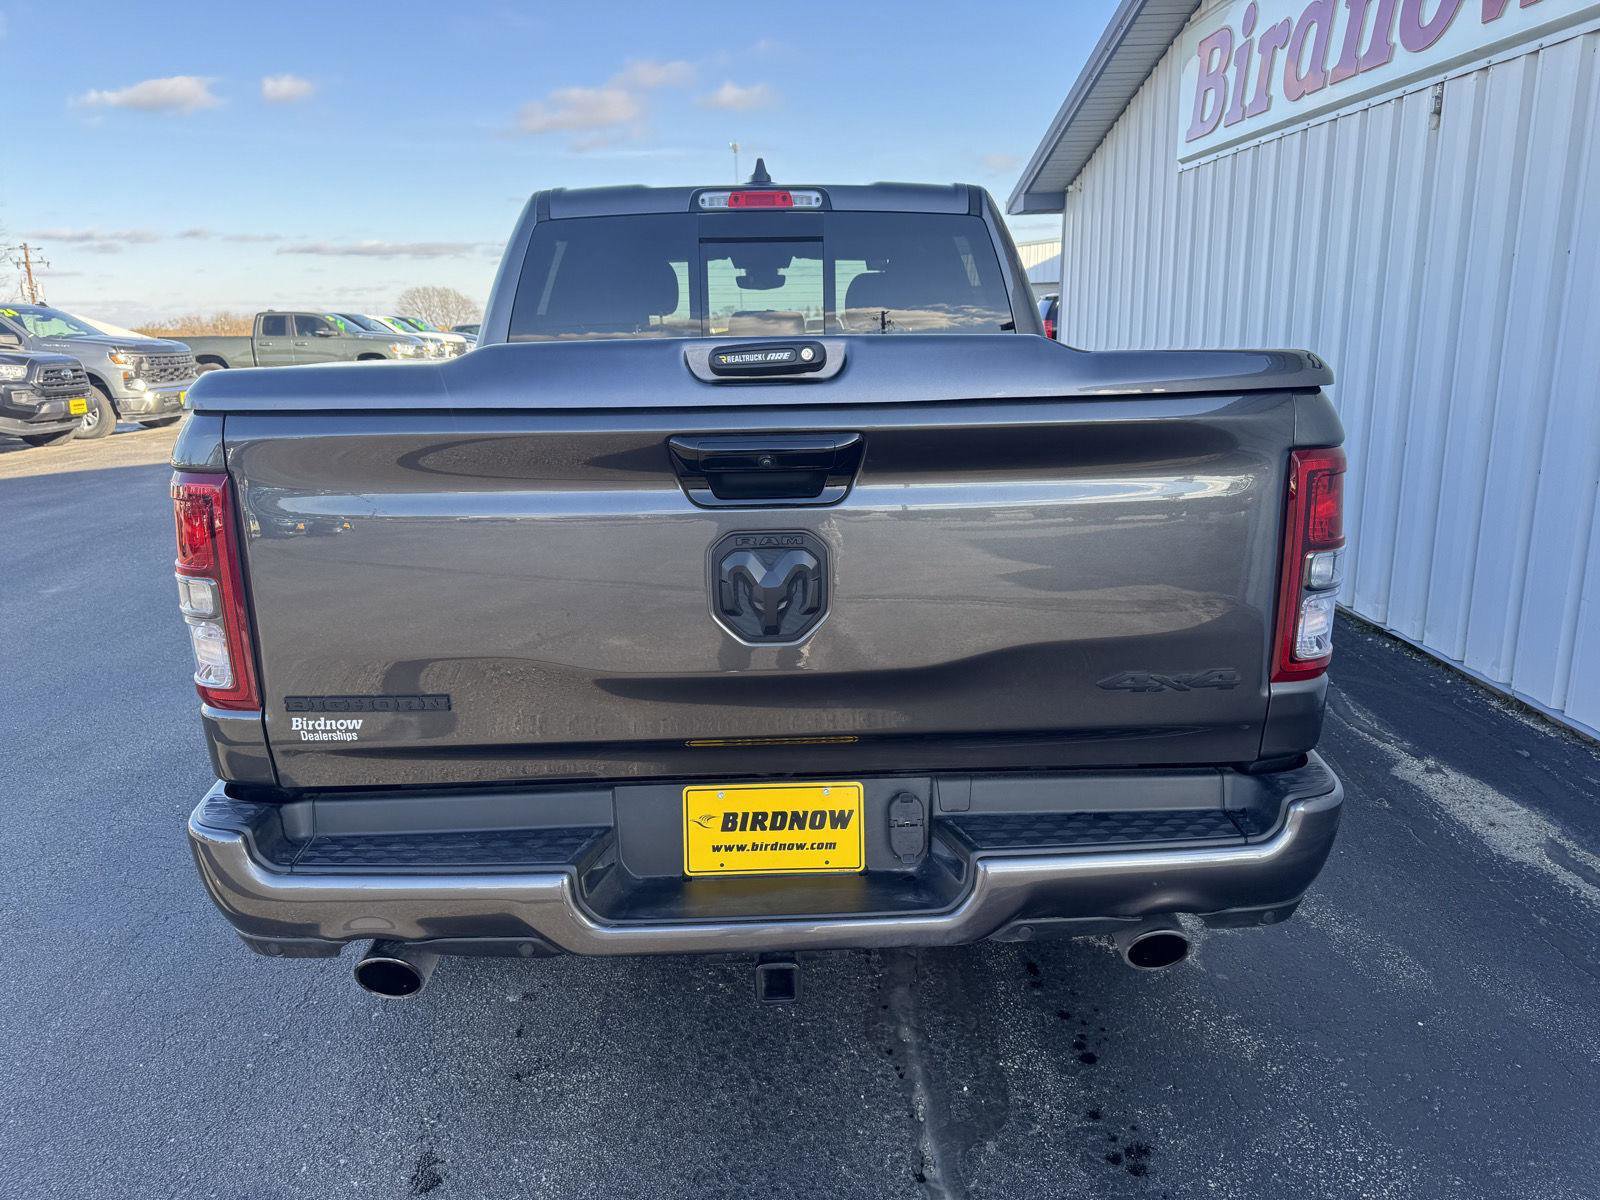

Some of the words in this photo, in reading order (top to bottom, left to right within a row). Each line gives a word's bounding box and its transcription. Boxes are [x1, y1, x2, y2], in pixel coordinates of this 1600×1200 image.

[1185, 0, 1544, 142] Birdno
[735, 535, 804, 546] RAM
[291, 717, 363, 730] Birdnow
[300, 730, 358, 741] Dealerships
[720, 809, 855, 832] BIRDNOW
[711, 841, 837, 853] www.birdnow.com
